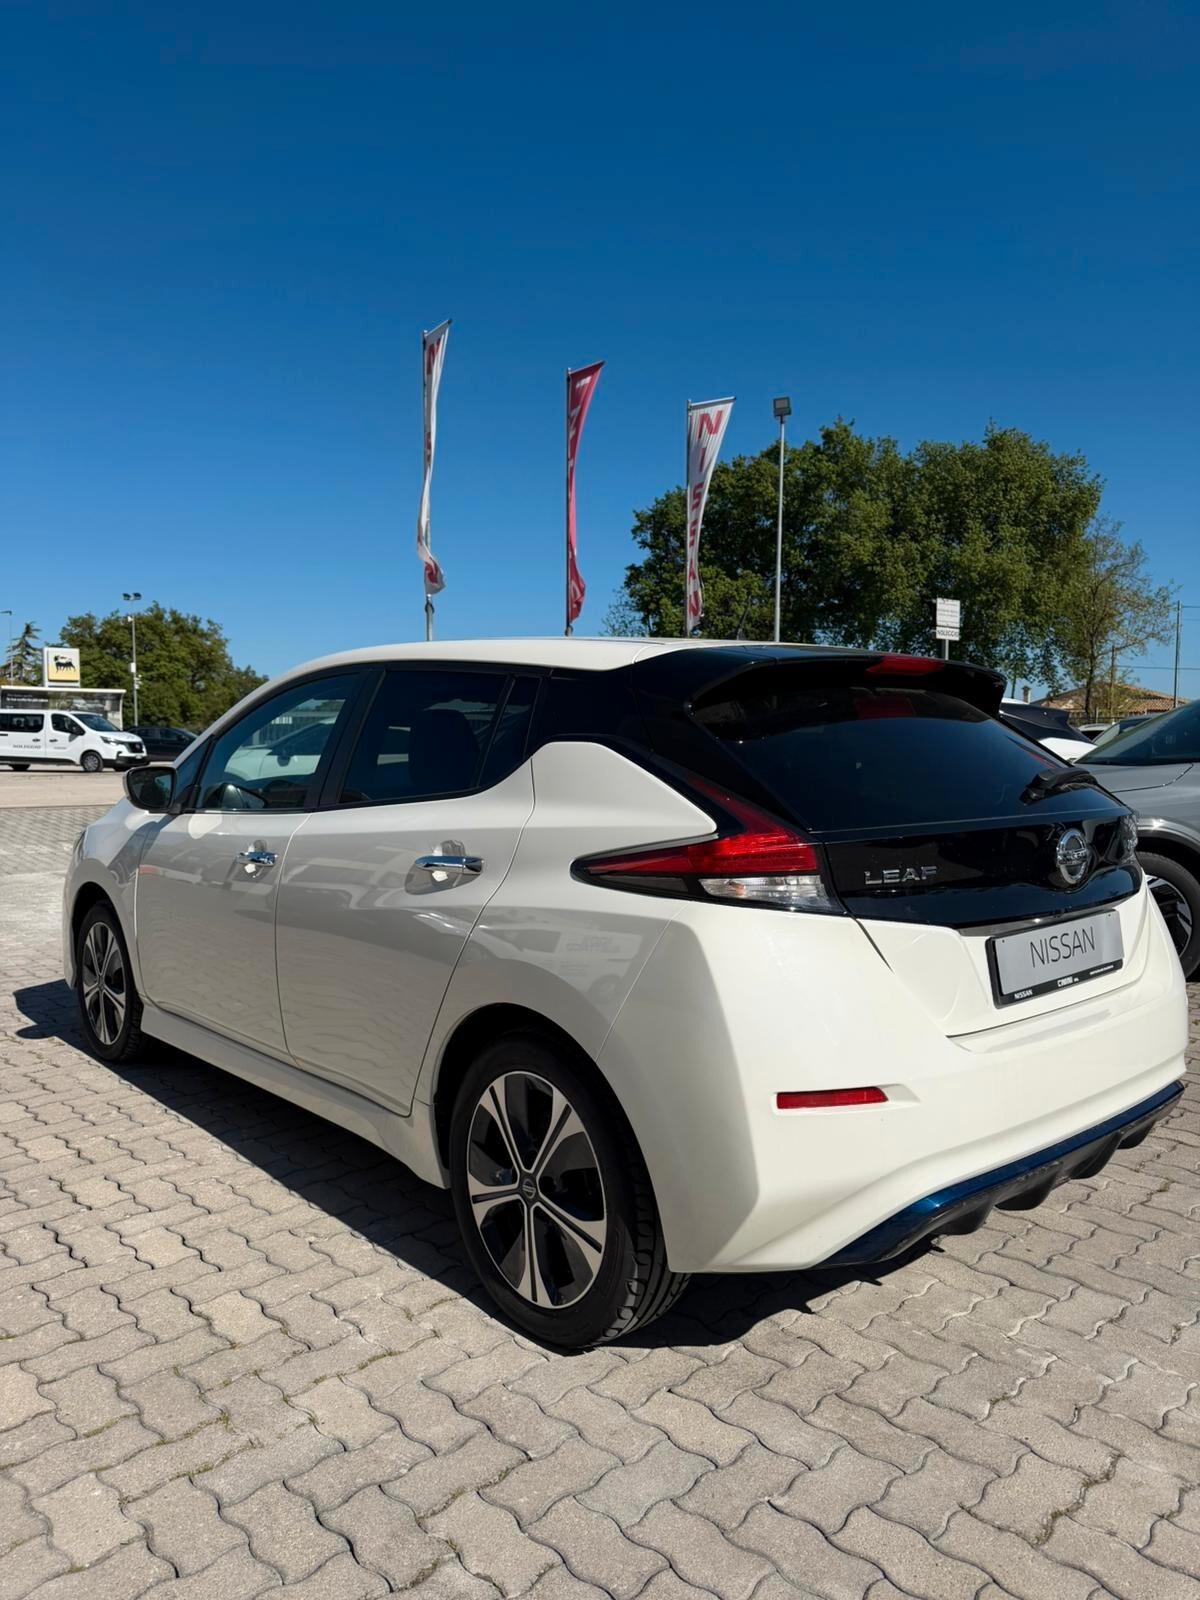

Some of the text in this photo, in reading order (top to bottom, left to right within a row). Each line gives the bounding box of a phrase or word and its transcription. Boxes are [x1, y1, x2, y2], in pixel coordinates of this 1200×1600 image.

[688, 410, 723, 617] NISSAN
[864, 865, 938, 885] LEAF
[1029, 925, 1096, 969] NISSAN
[1014, 988, 1033, 1000] NISSAN
